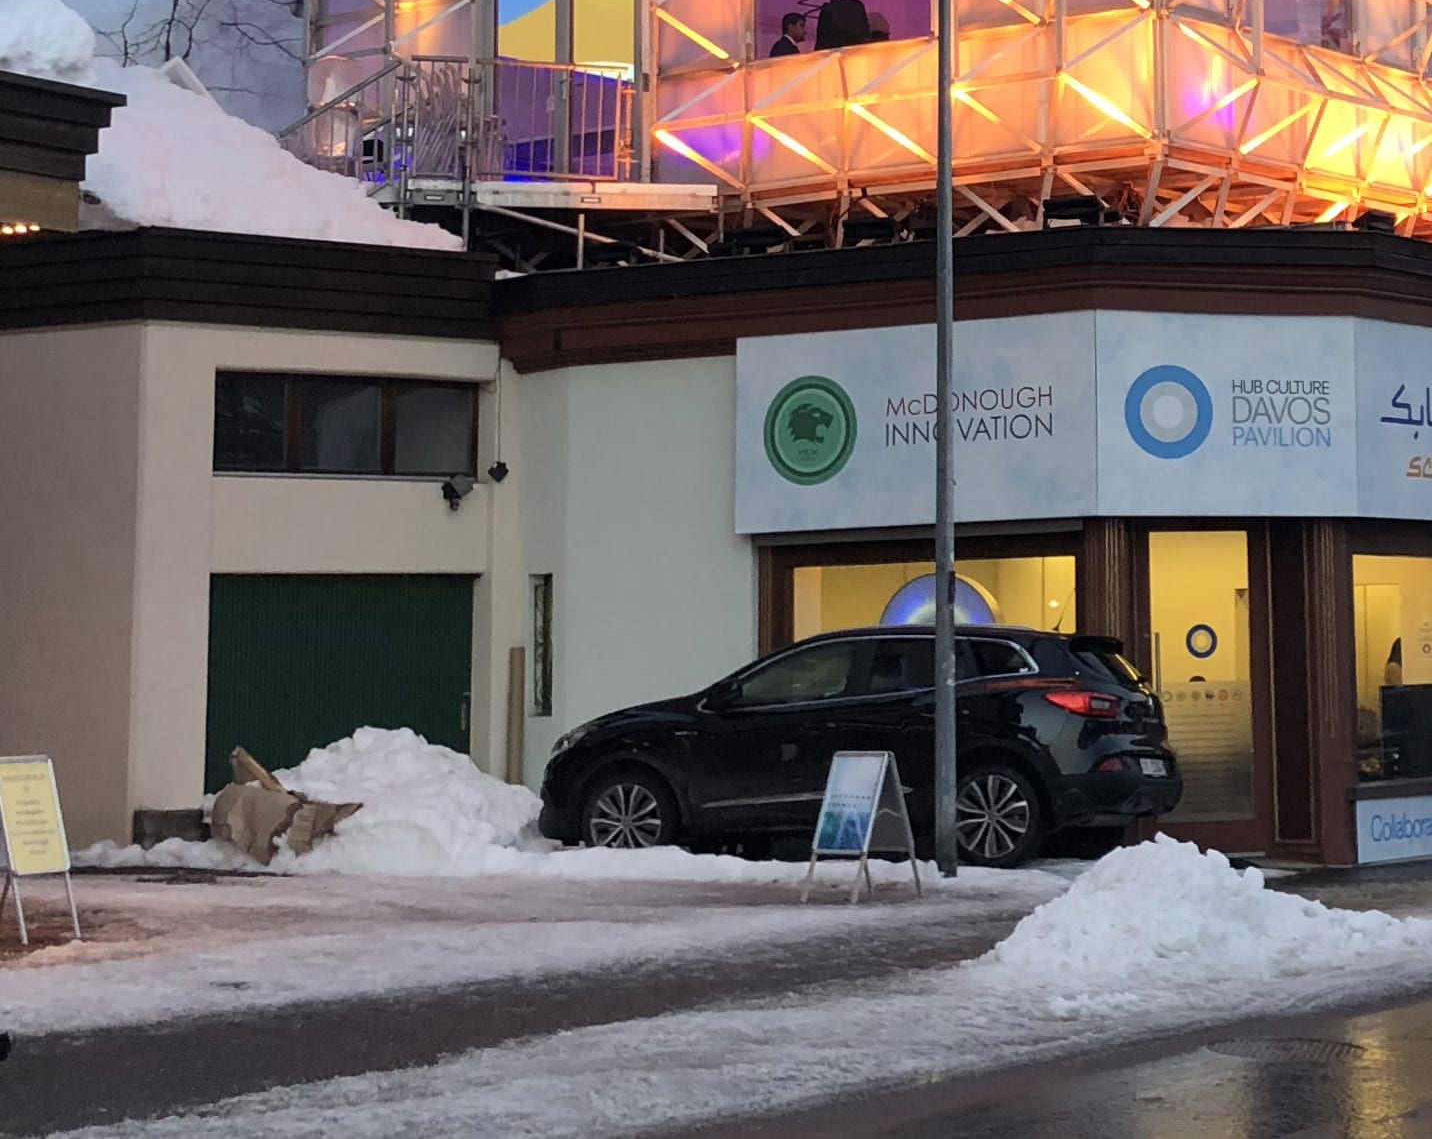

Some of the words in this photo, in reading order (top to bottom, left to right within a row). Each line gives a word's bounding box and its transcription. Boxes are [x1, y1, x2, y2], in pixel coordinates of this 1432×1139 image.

[1232, 379, 1263, 394] HUB
[1266, 379, 1330, 395] CULTURE
[1232, 396, 1331, 425] DAVOS
[885, 413, 1053, 447] INNVATION
[1232, 426, 1331, 448] PAVILION
